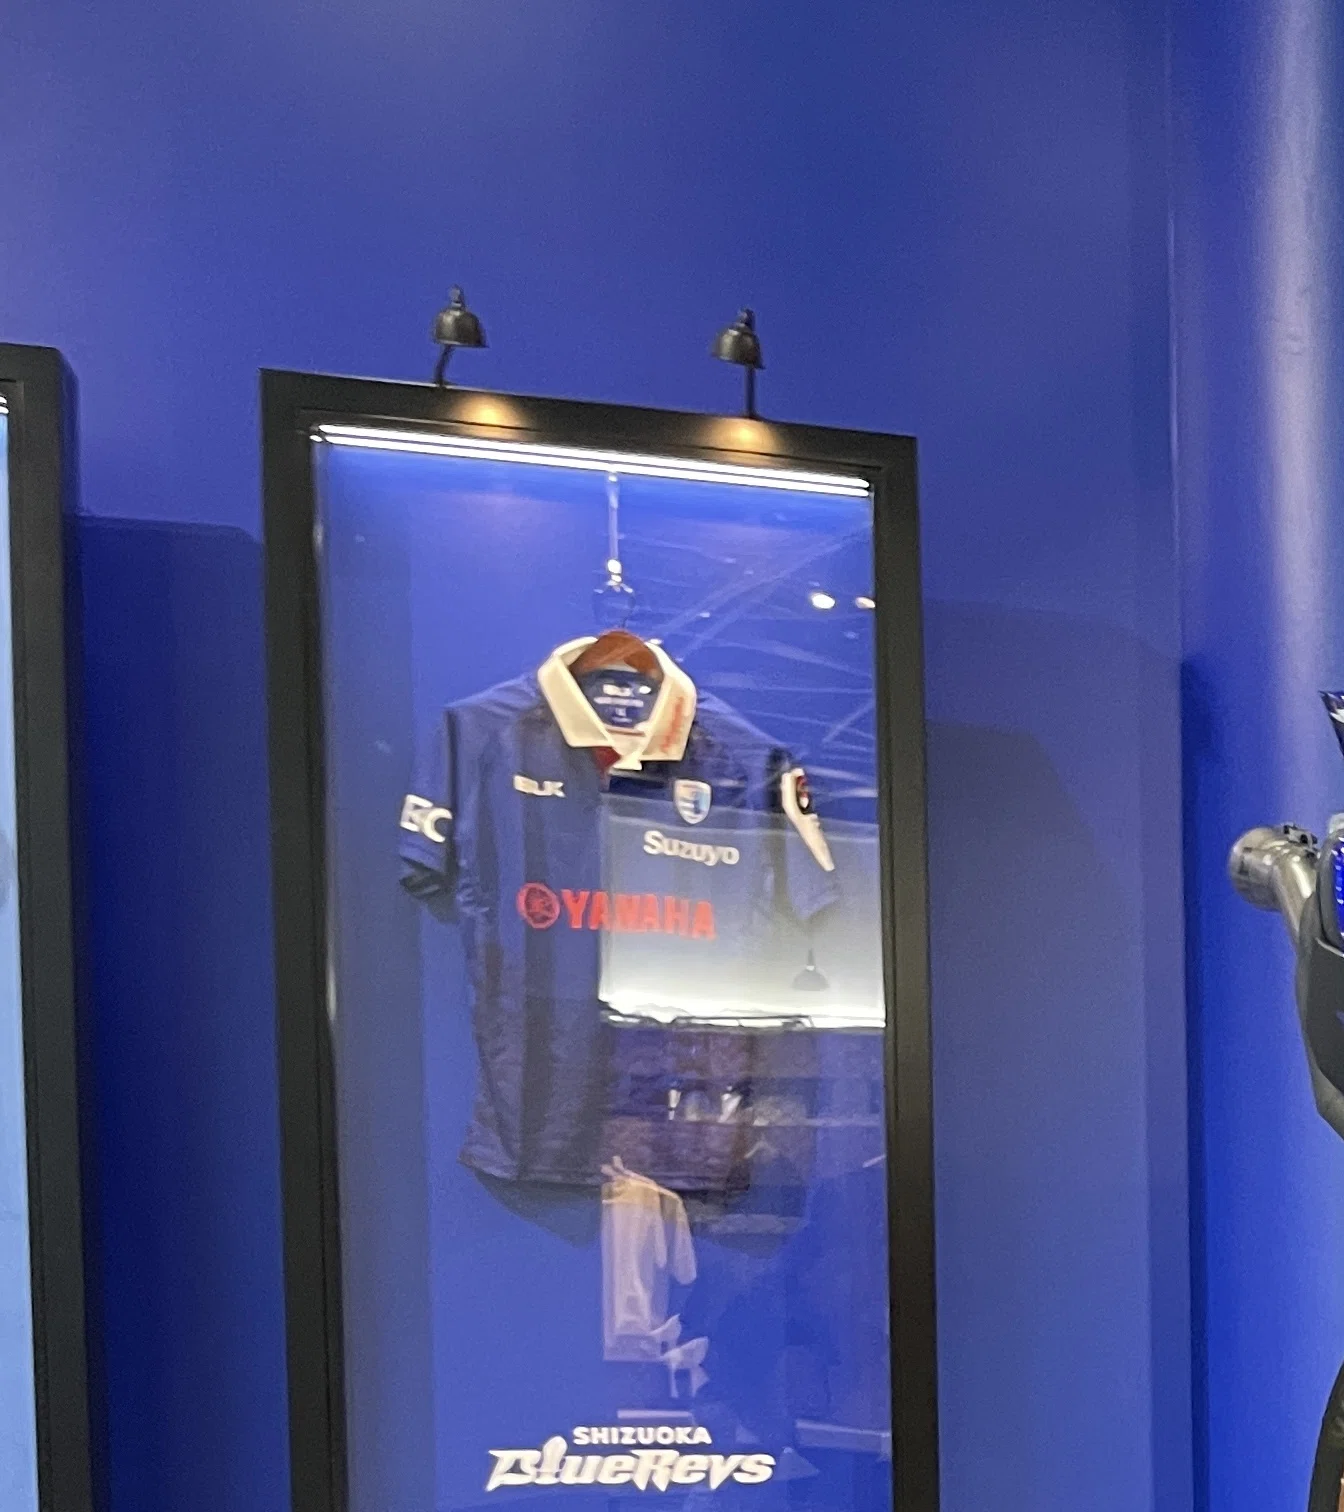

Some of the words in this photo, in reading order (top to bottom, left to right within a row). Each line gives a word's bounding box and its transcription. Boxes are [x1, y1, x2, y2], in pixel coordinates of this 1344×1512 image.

[513, 775, 565, 798] BLK
[642, 830, 740, 867] Suzuyo
[561, 889, 717, 941] YAMAHA
[572, 1426, 713, 1446] SHIZUOKA
